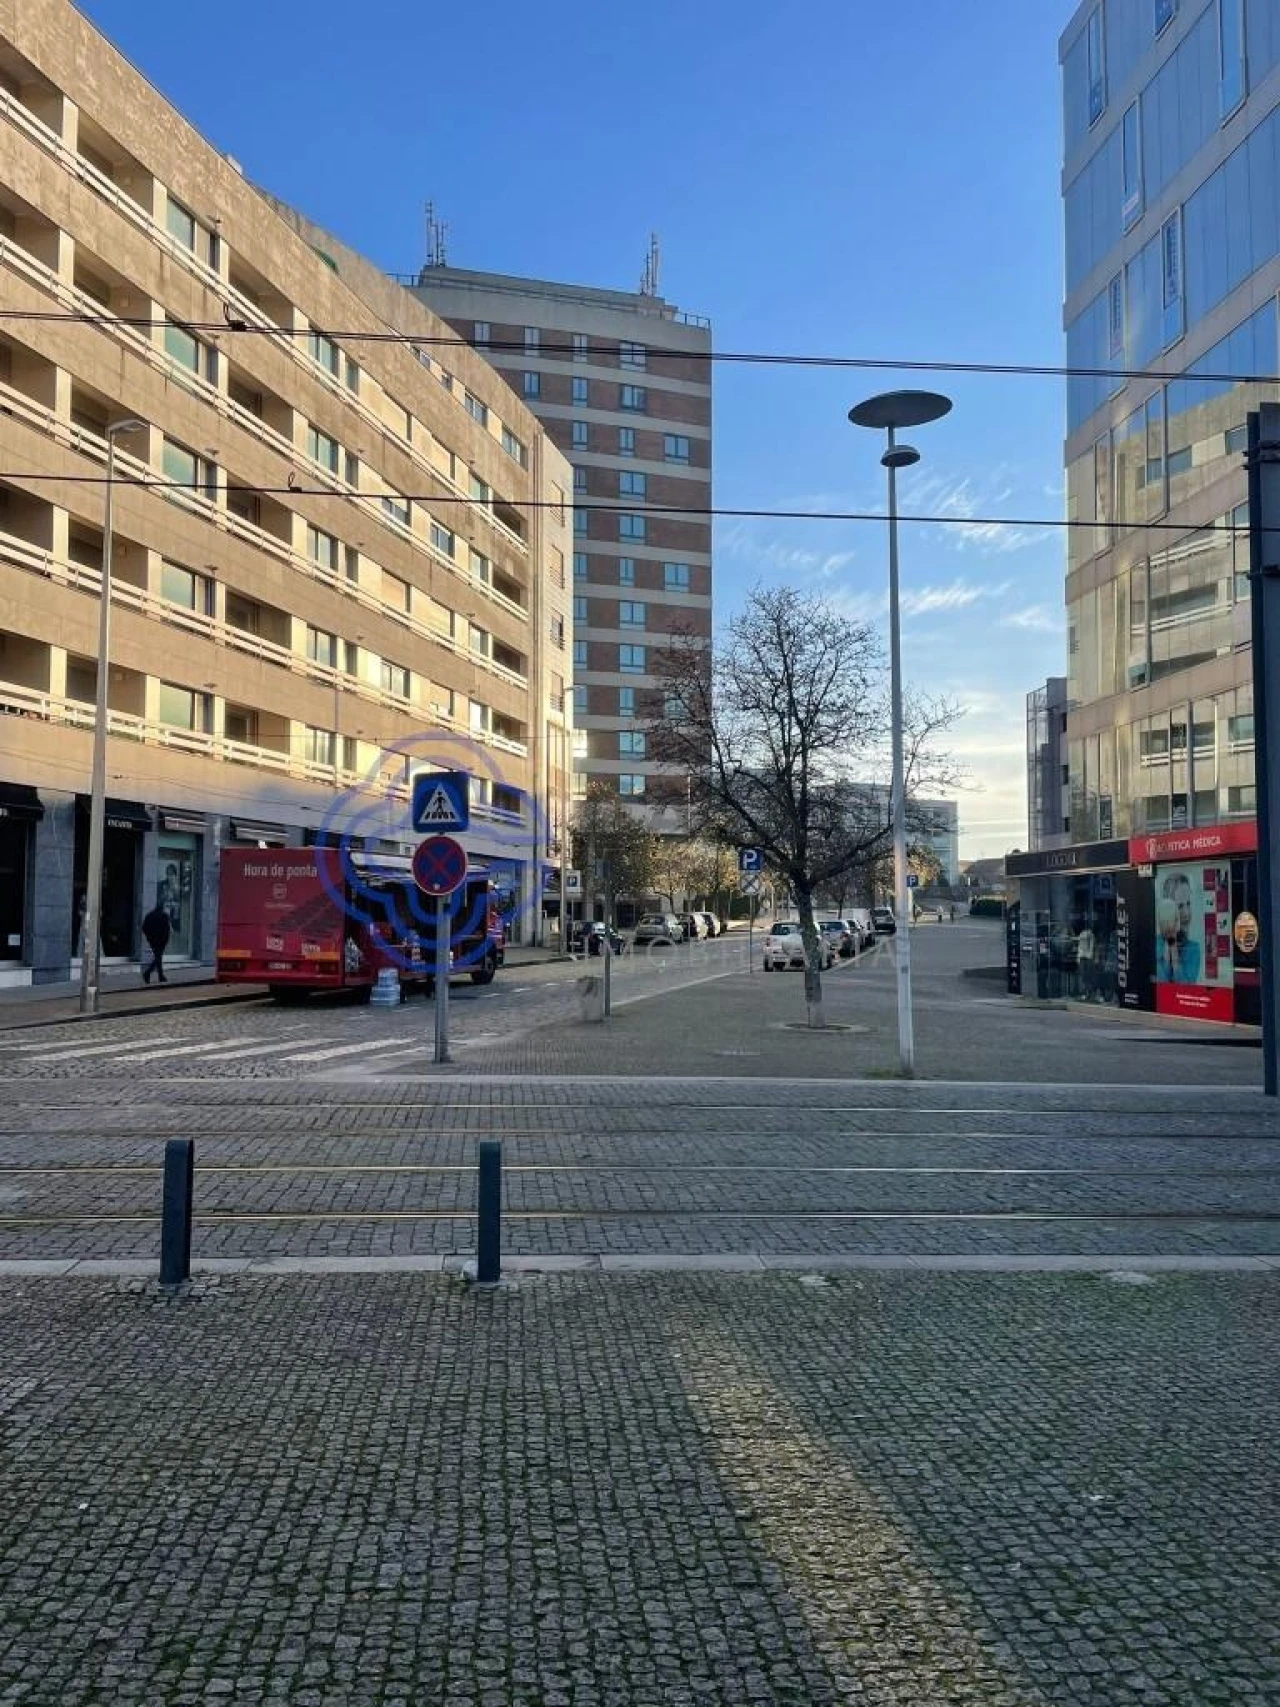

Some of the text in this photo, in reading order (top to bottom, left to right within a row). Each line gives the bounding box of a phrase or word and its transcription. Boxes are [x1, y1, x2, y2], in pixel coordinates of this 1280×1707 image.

[743, 849, 758, 869] P
[244, 862, 318, 881] Hora de ponta
[1117, 892, 1128, 988] OUTLET
